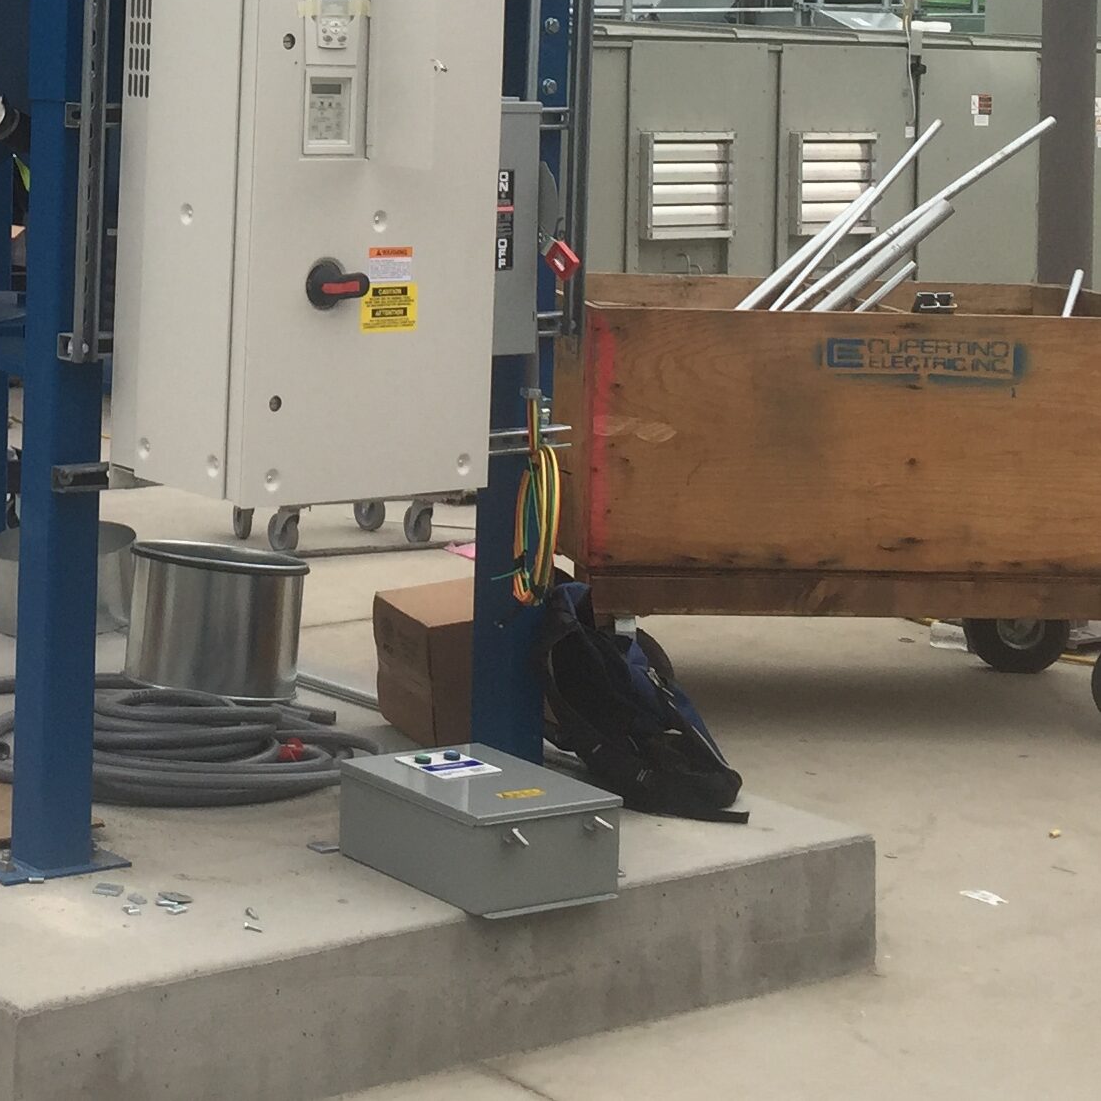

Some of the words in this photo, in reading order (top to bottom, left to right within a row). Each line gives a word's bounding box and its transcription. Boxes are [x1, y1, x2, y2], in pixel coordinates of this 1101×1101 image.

[499, 171, 509, 192] ON
[497, 238, 508, 269] OFF
[867, 338, 1011, 358] CUPERTINO
